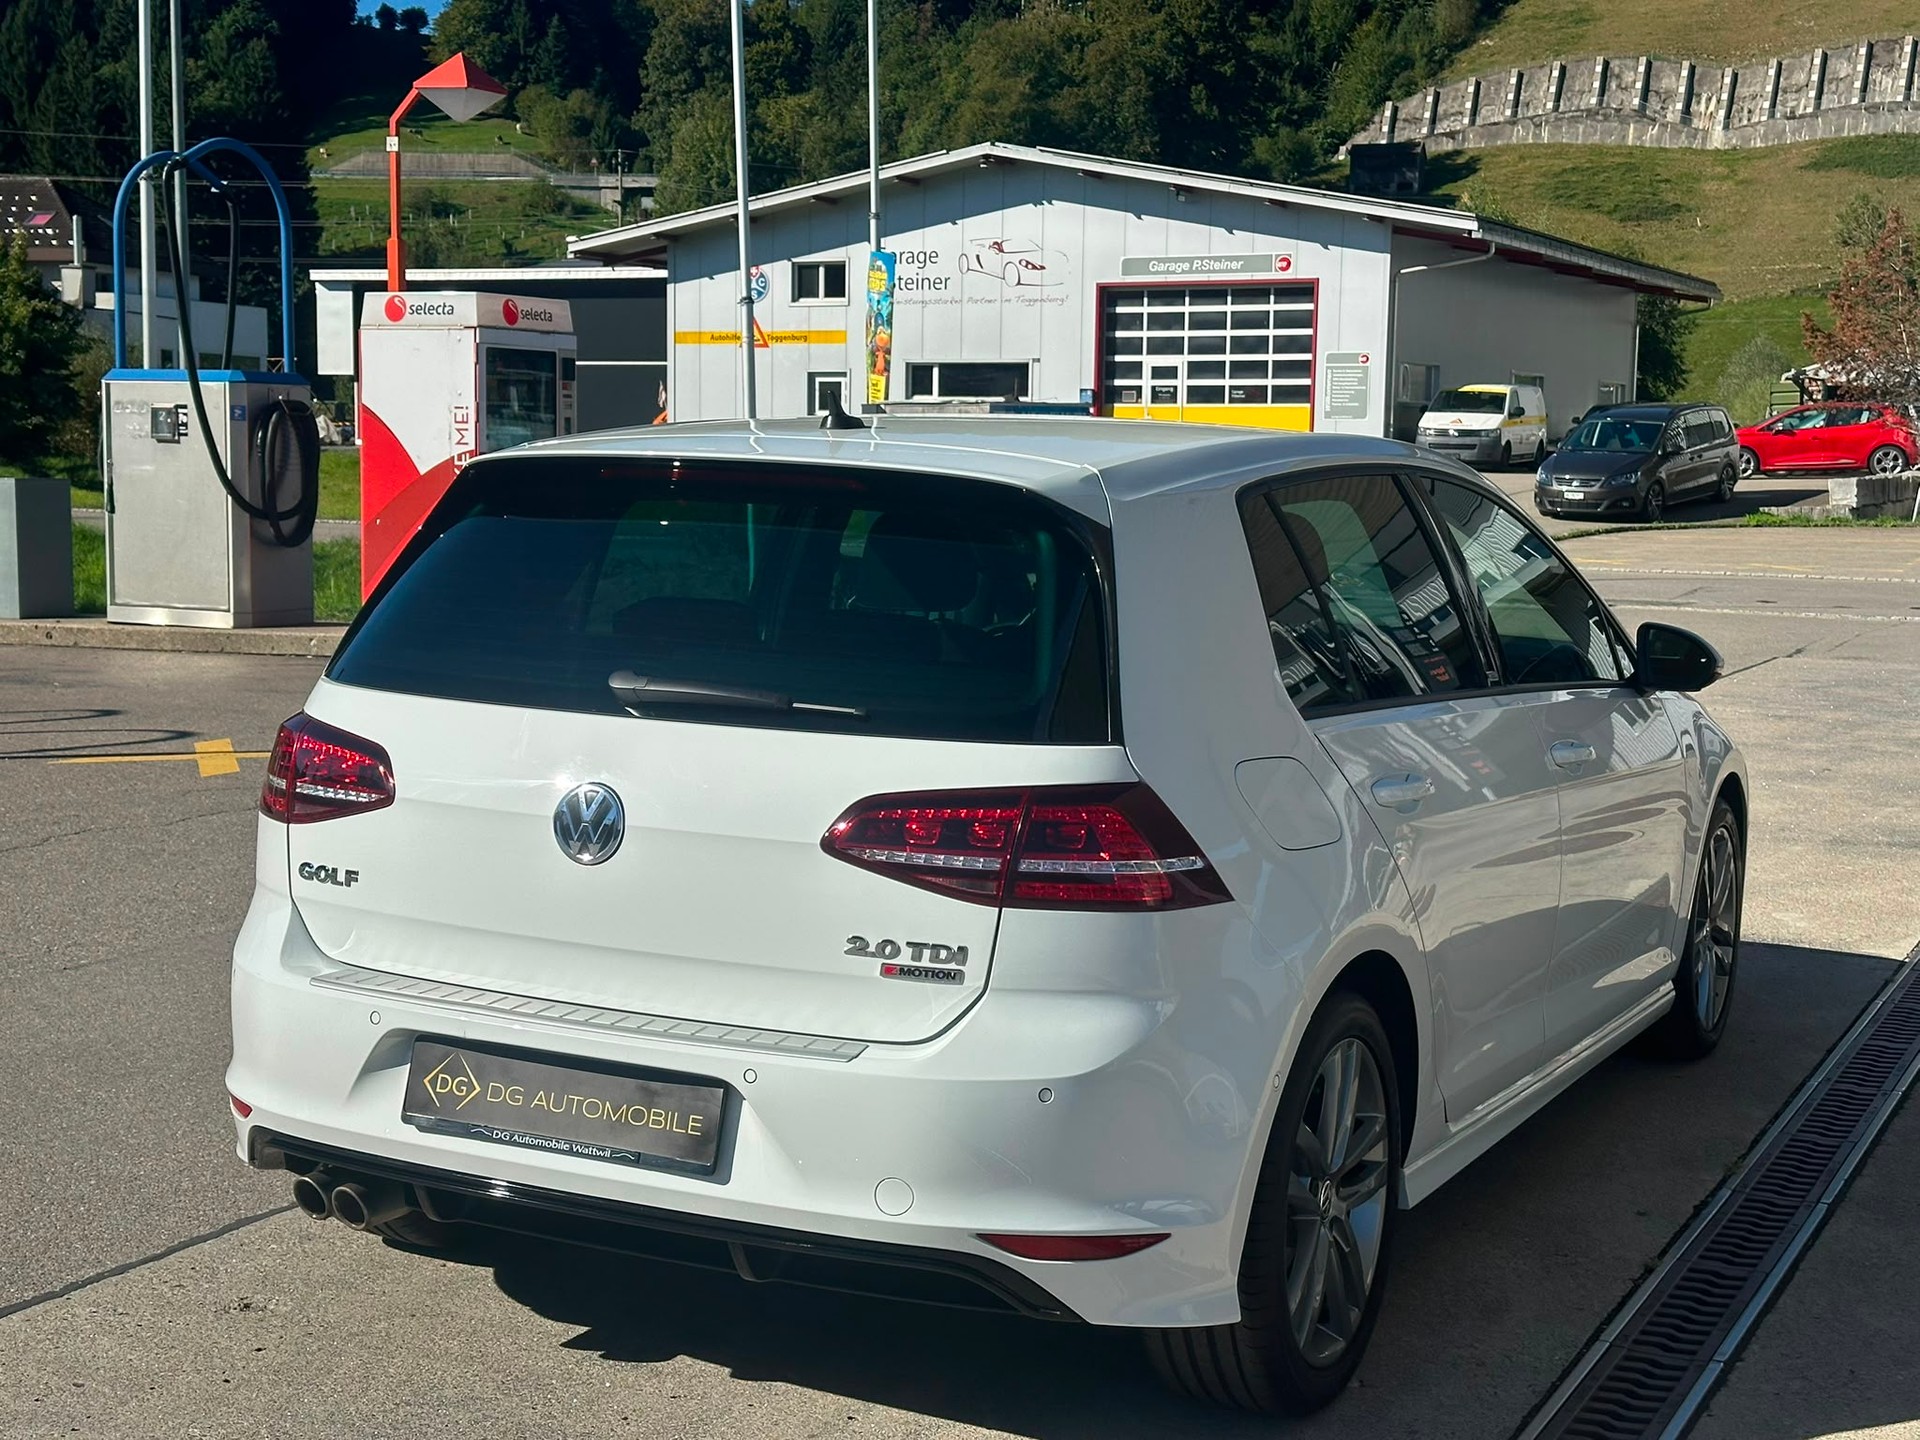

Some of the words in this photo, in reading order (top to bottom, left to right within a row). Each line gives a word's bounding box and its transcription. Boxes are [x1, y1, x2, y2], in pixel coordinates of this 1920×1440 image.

[1148, 260, 1190, 273] Garage
[1192, 259, 1244, 271] P.Steiner
[893, 272, 951, 291] teiner
[408, 301, 455, 316] selecta
[519, 307, 553, 322] selecta
[766, 334, 808, 343] Toggenburg
[453, 405, 469, 446] ME!
[298, 861, 360, 888] GOLF
[843, 935, 902, 961] 2.0
[905, 941, 969, 967] TDI
[435, 1074, 468, 1097] DG
[486, 1082, 524, 1106] DG
[530, 1090, 704, 1136] AUTOMOBILE
[492, 1130, 510, 1141] DG
[511, 1133, 570, 1151] Automobile
[572, 1142, 611, 1158] Wattwil
